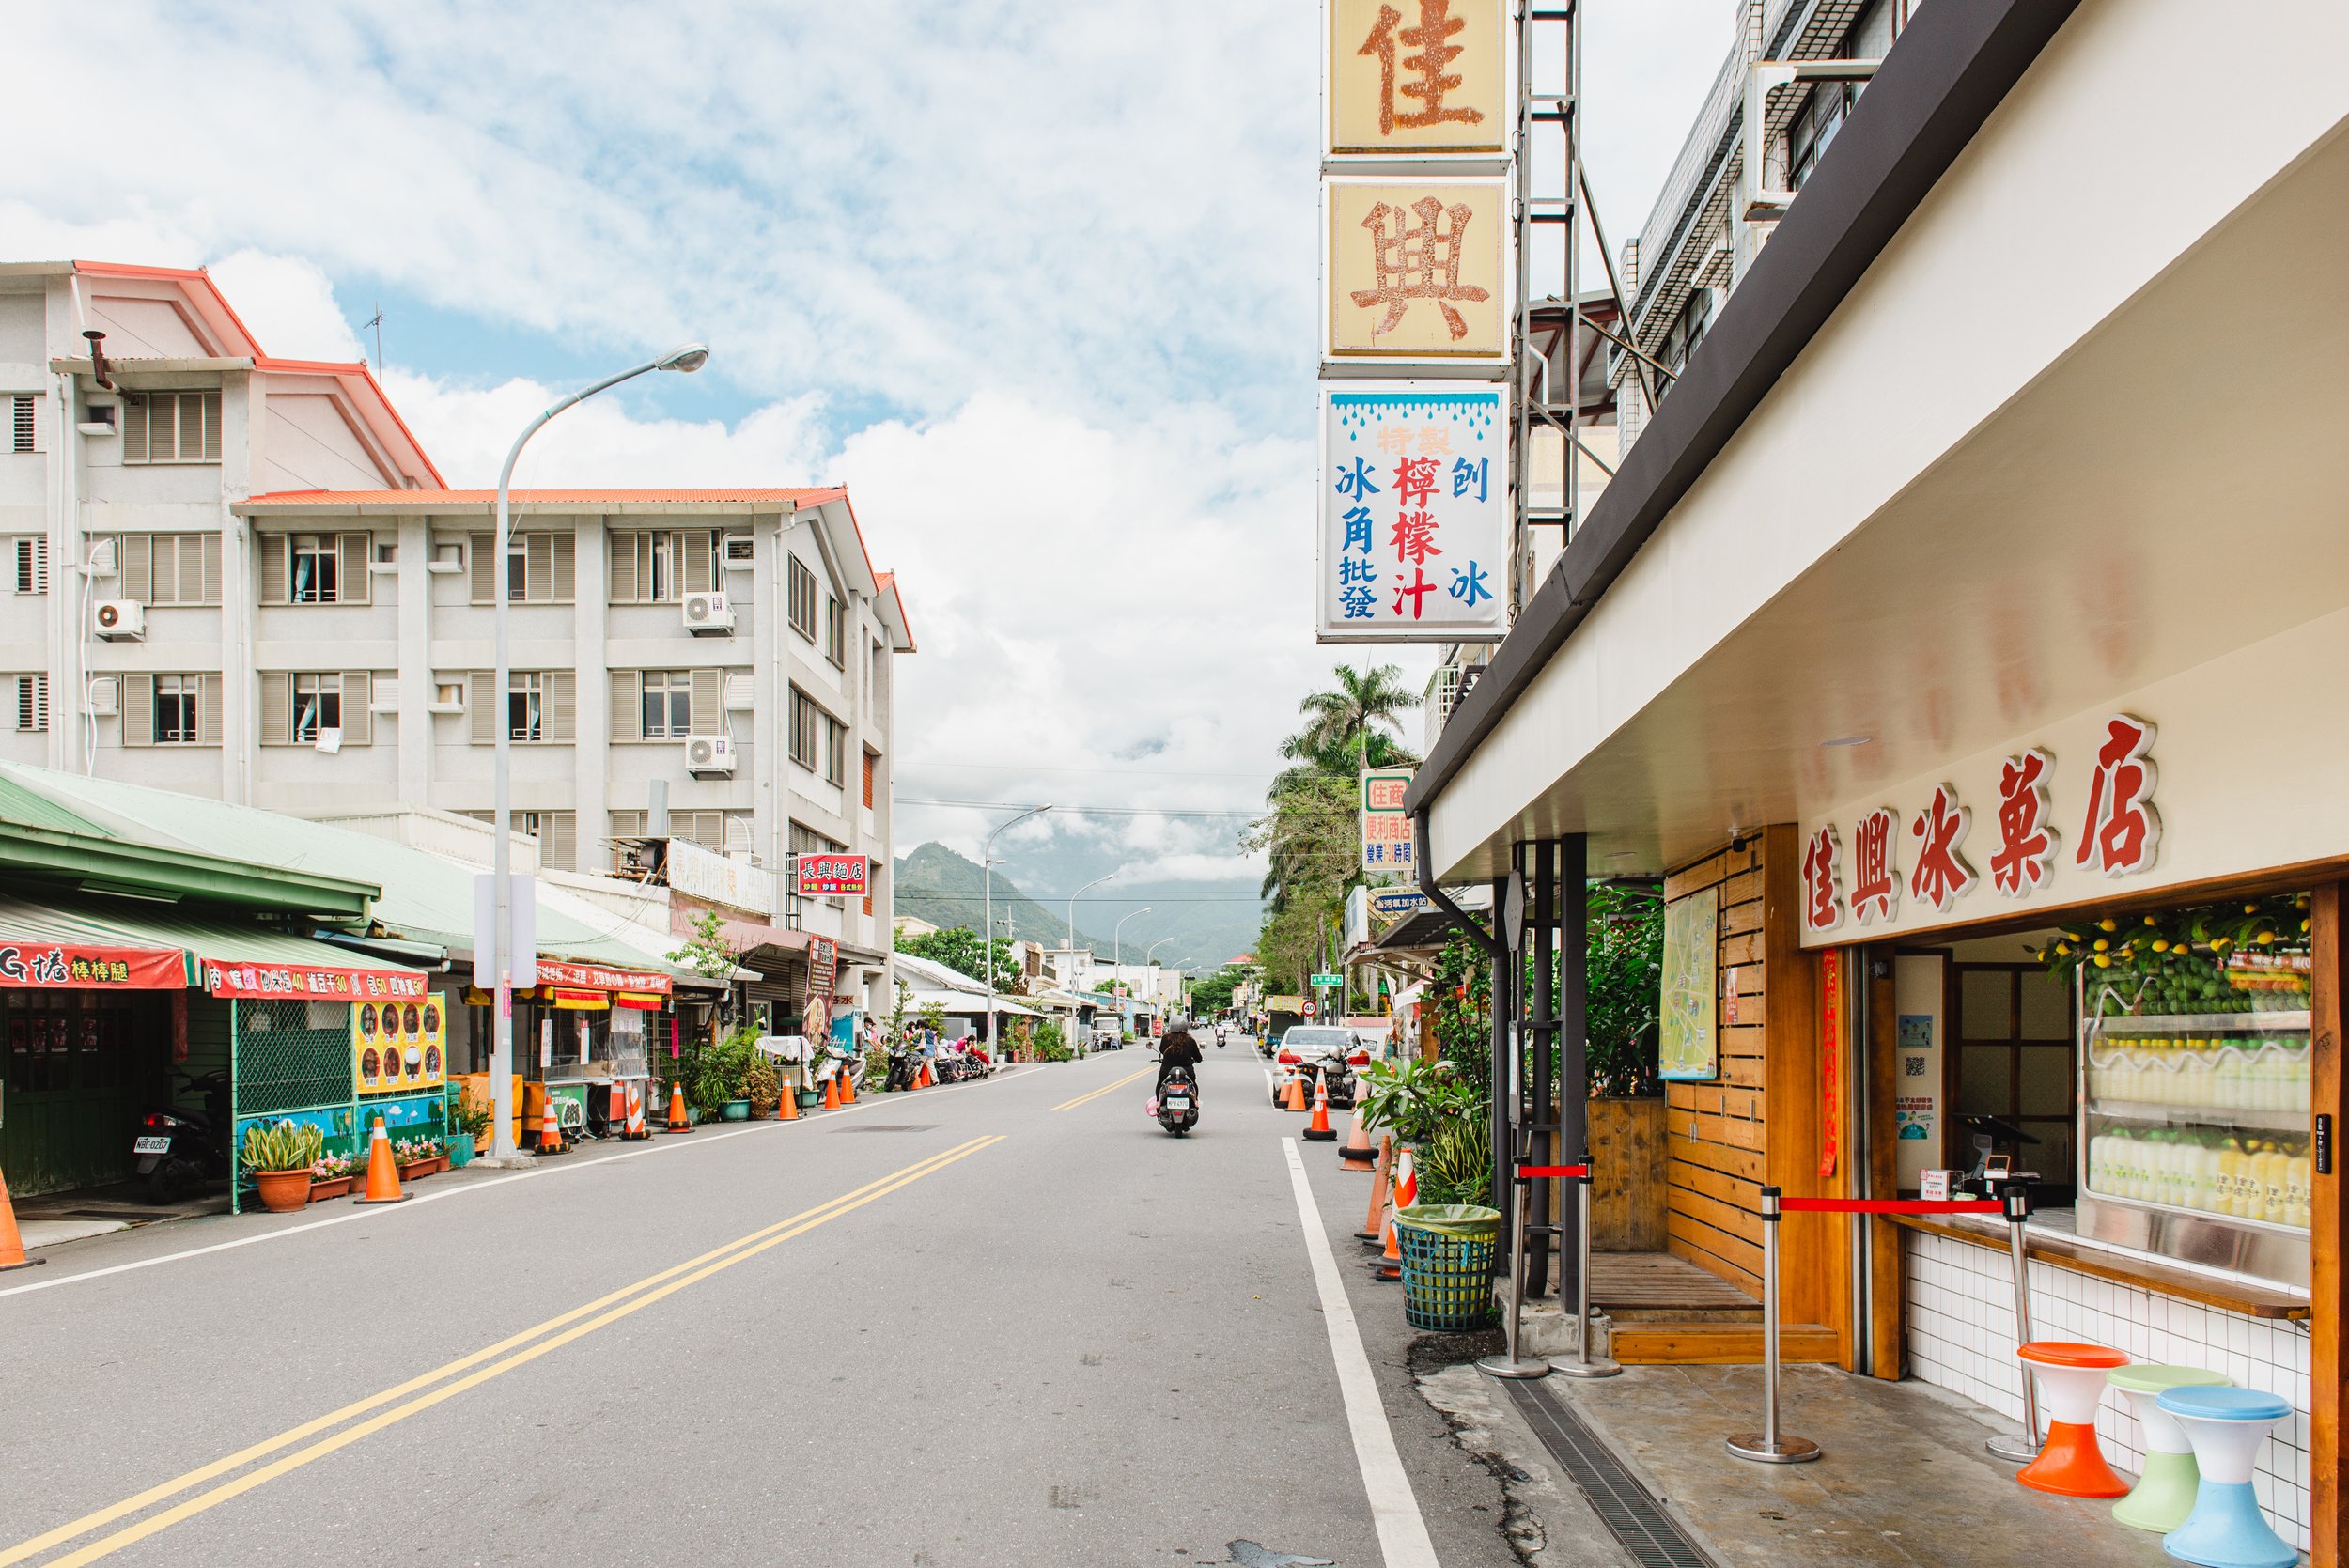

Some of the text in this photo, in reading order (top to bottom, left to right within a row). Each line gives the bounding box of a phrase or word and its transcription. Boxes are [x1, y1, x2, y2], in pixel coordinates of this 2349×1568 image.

[1350, 0, 1491, 342] 佳興
[1377, 425, 1455, 456] 特製
[1335, 457, 1380, 619] 冰角批發
[1389, 457, 1444, 621] 檸檬汁
[1448, 457, 1494, 608] 刨冰
[801, 862, 863, 880] 長興麵店
[1366, 815, 1411, 840] 便利商店
[1803, 717, 2152, 930] 佳興冰菓店
[71, 959, 128, 982] 棒棒腿
